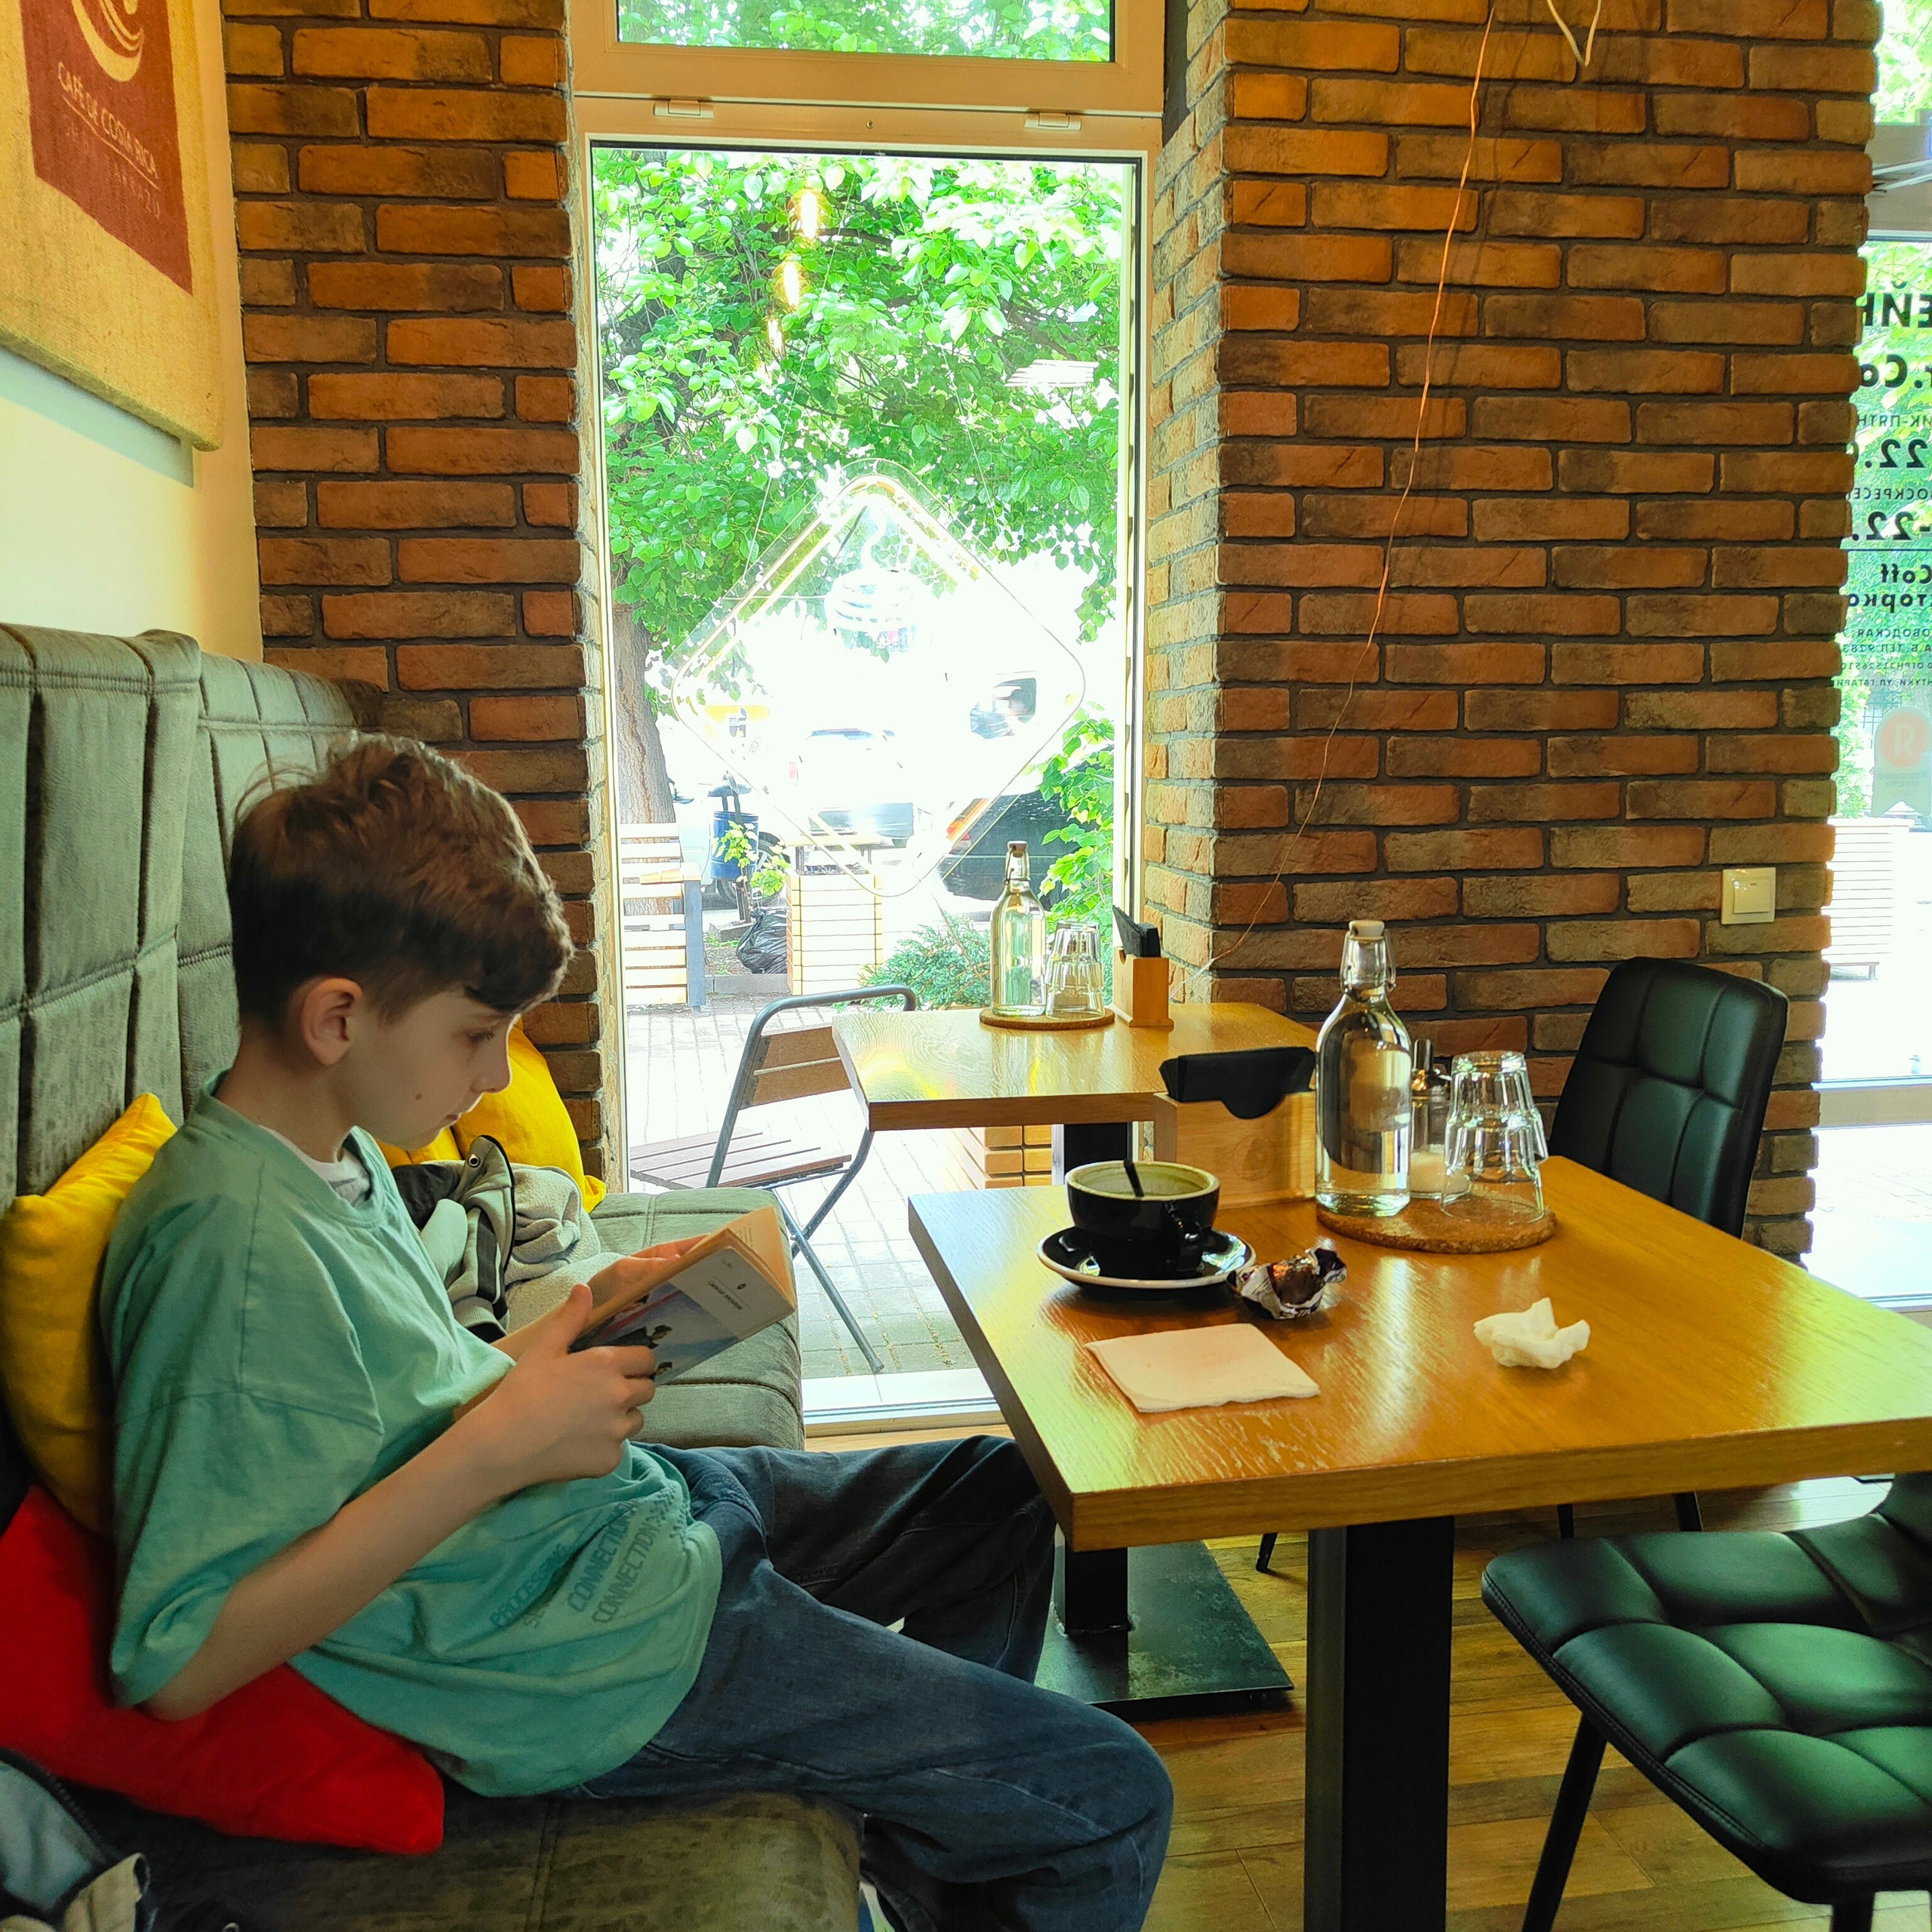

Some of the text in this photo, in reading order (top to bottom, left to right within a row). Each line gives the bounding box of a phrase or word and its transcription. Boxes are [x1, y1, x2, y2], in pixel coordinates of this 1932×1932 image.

[101, 108, 134, 156] COSTA
[134, 137, 158, 180] RICA
[592, 1521, 661, 1623] CONNECTION
